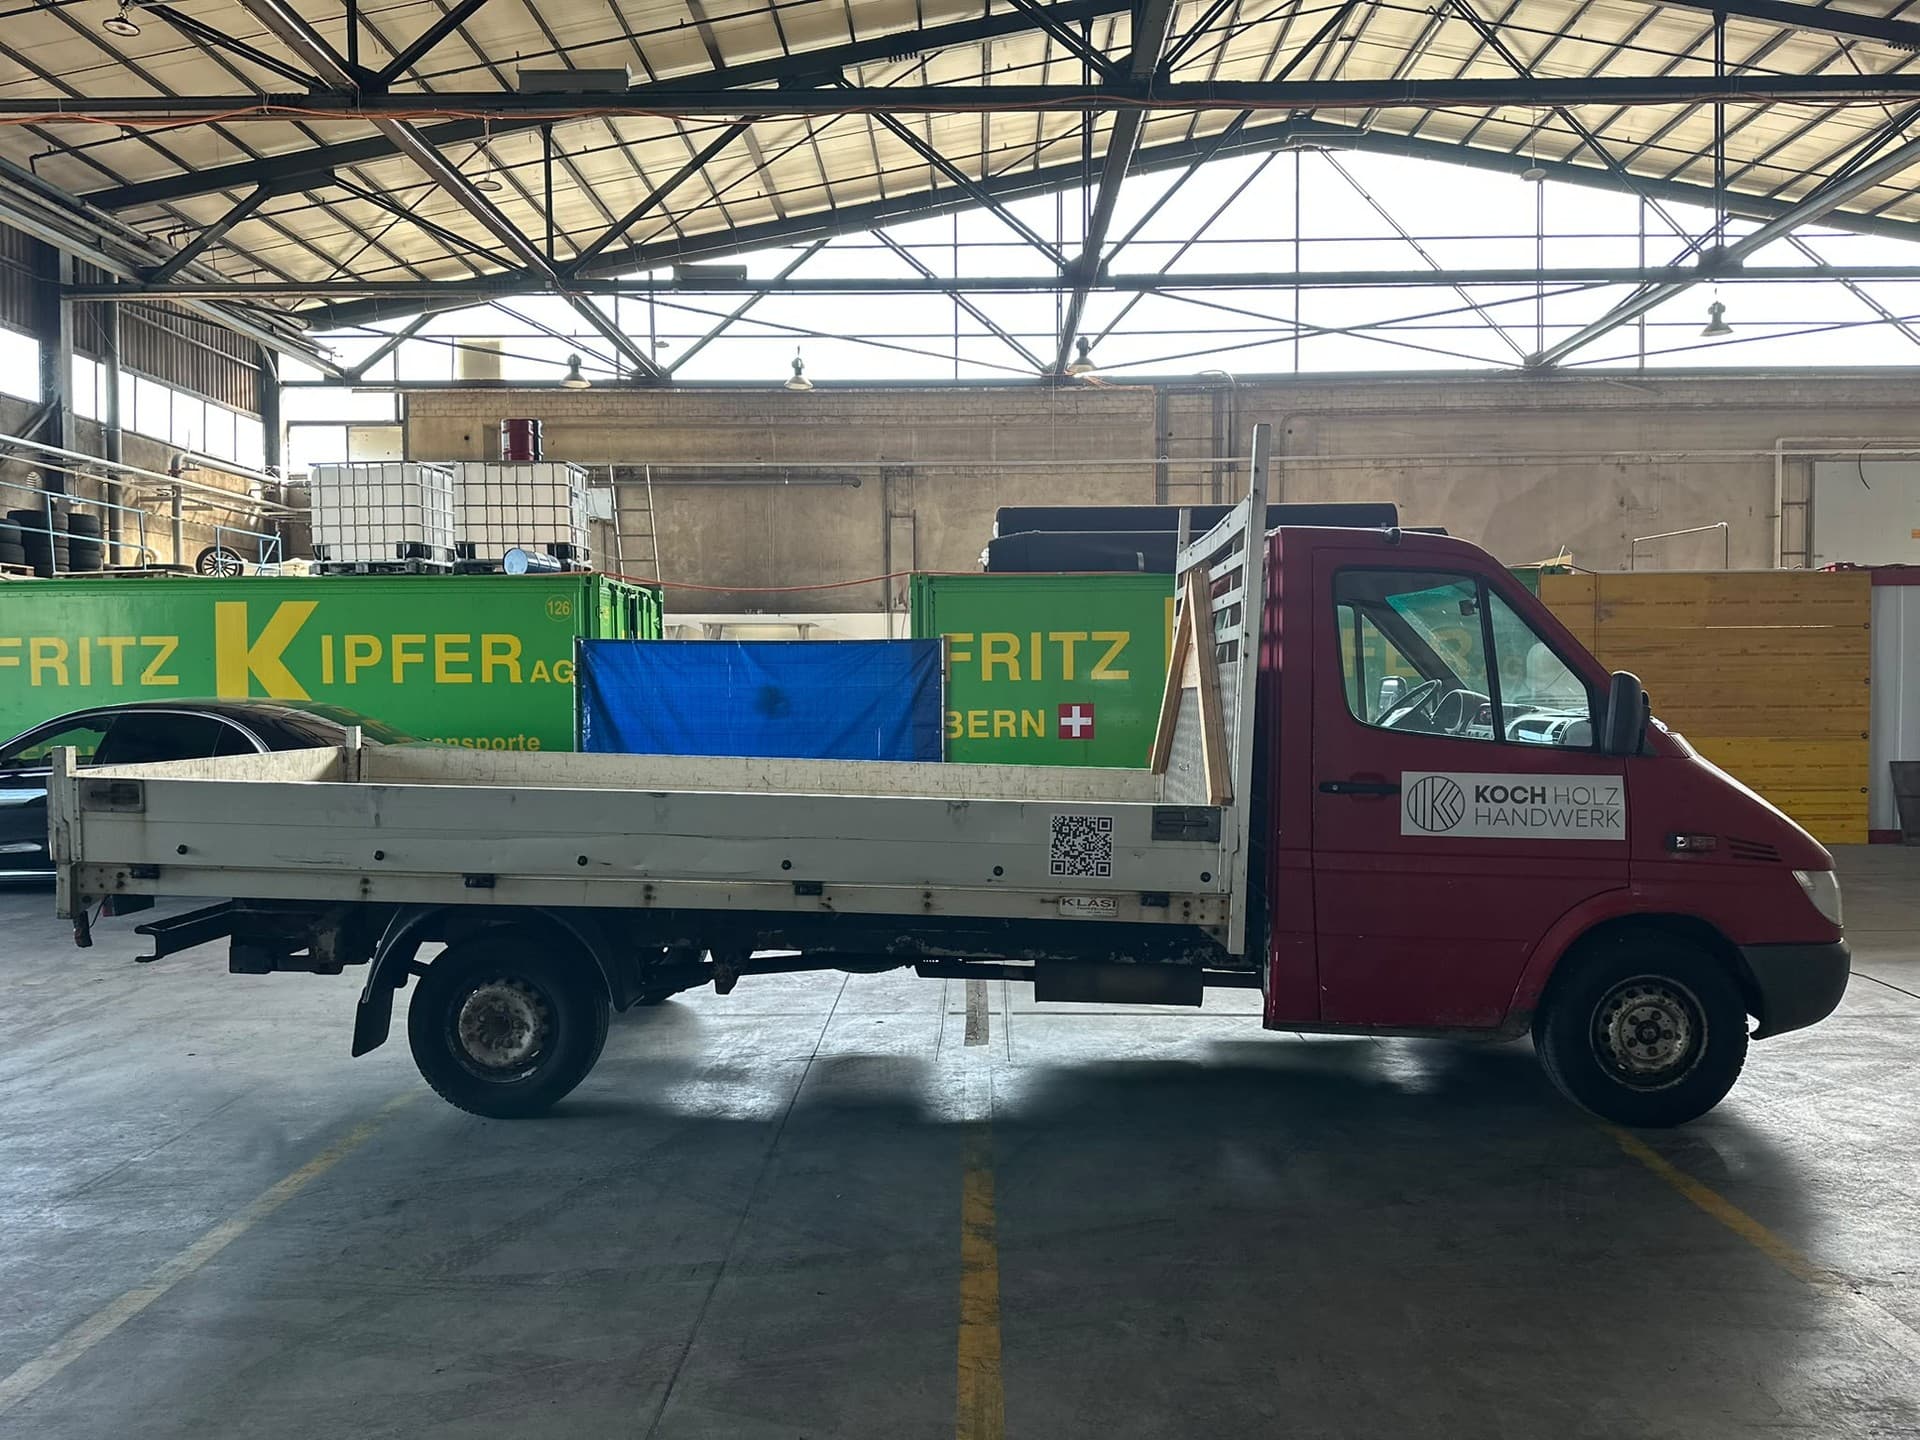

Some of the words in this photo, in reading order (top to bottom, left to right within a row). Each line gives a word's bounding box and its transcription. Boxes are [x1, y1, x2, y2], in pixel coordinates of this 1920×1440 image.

[548, 600, 570, 616] 126
[0, 635, 179, 687] FRITZ
[215, 600, 523, 702] KIPFER
[530, 659, 574, 684] AG
[943, 631, 1130, 682] FRITZ
[945, 709, 1046, 739] BERN
[1474, 785, 1547, 805] KOCH
[1553, 786, 1620, 806] HOLZ
[1474, 807, 1621, 828] HANDWERK
